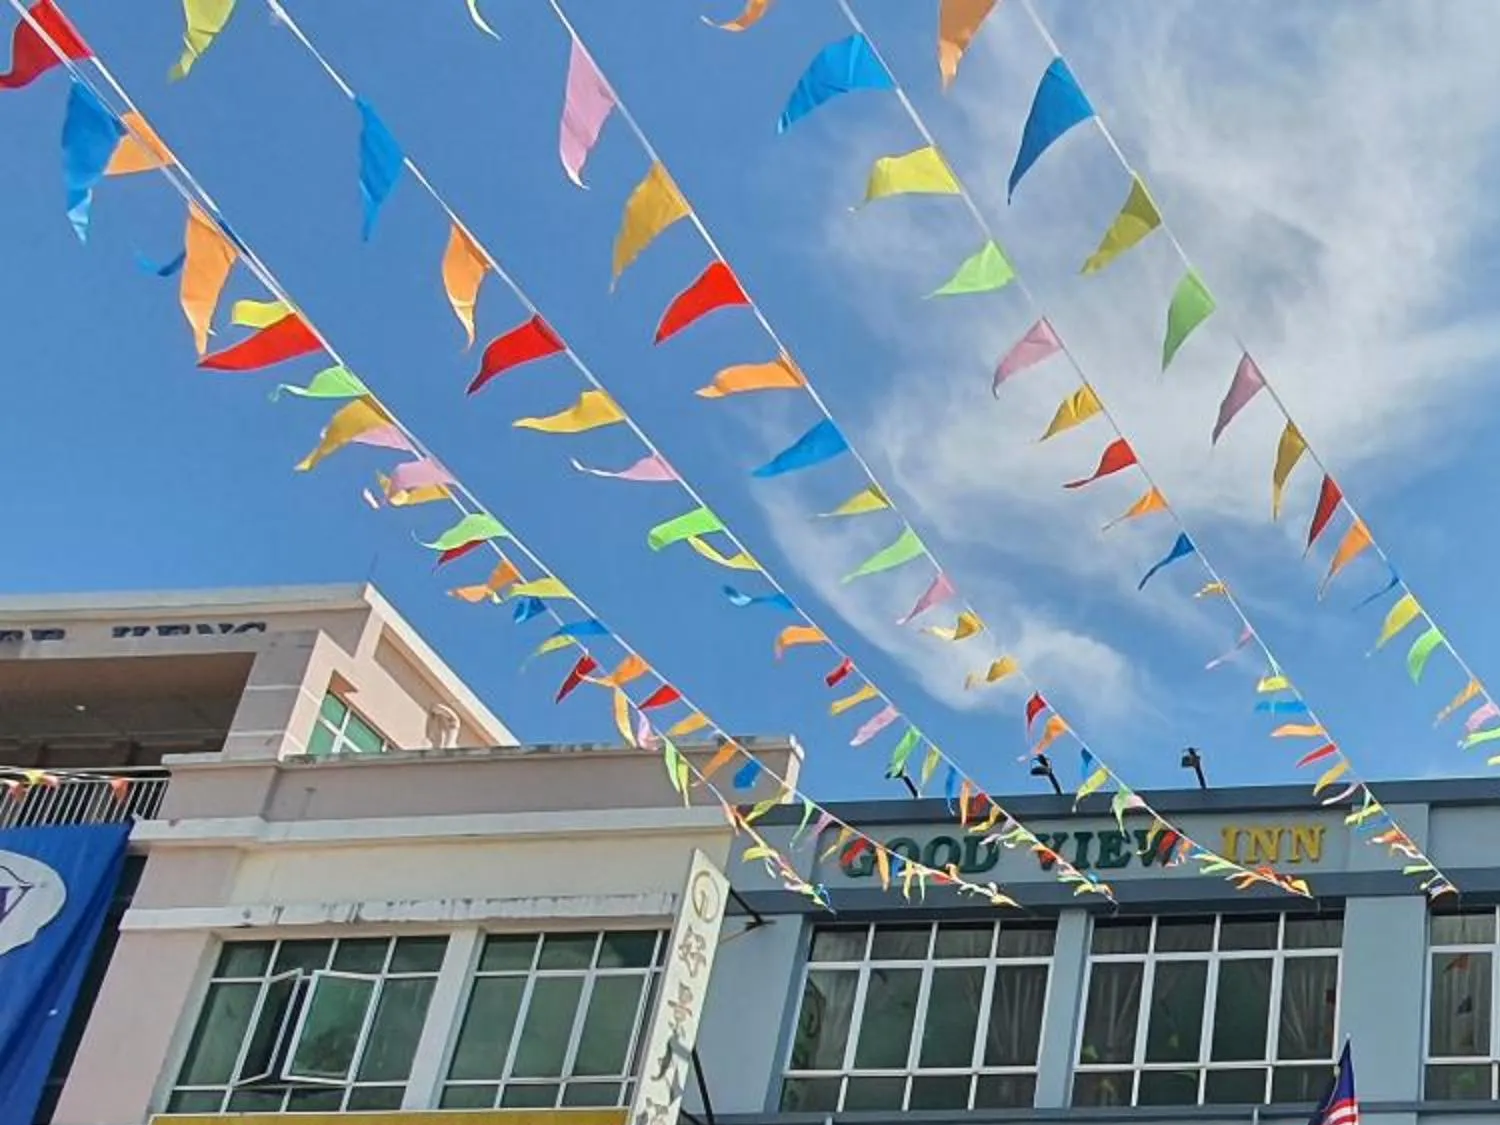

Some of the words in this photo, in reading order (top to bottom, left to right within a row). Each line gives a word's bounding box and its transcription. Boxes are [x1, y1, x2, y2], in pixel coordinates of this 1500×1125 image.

[840, 833, 1001, 878] GOOD
[1036, 828, 1183, 872] VIEW
[1220, 822, 1326, 865] INN
